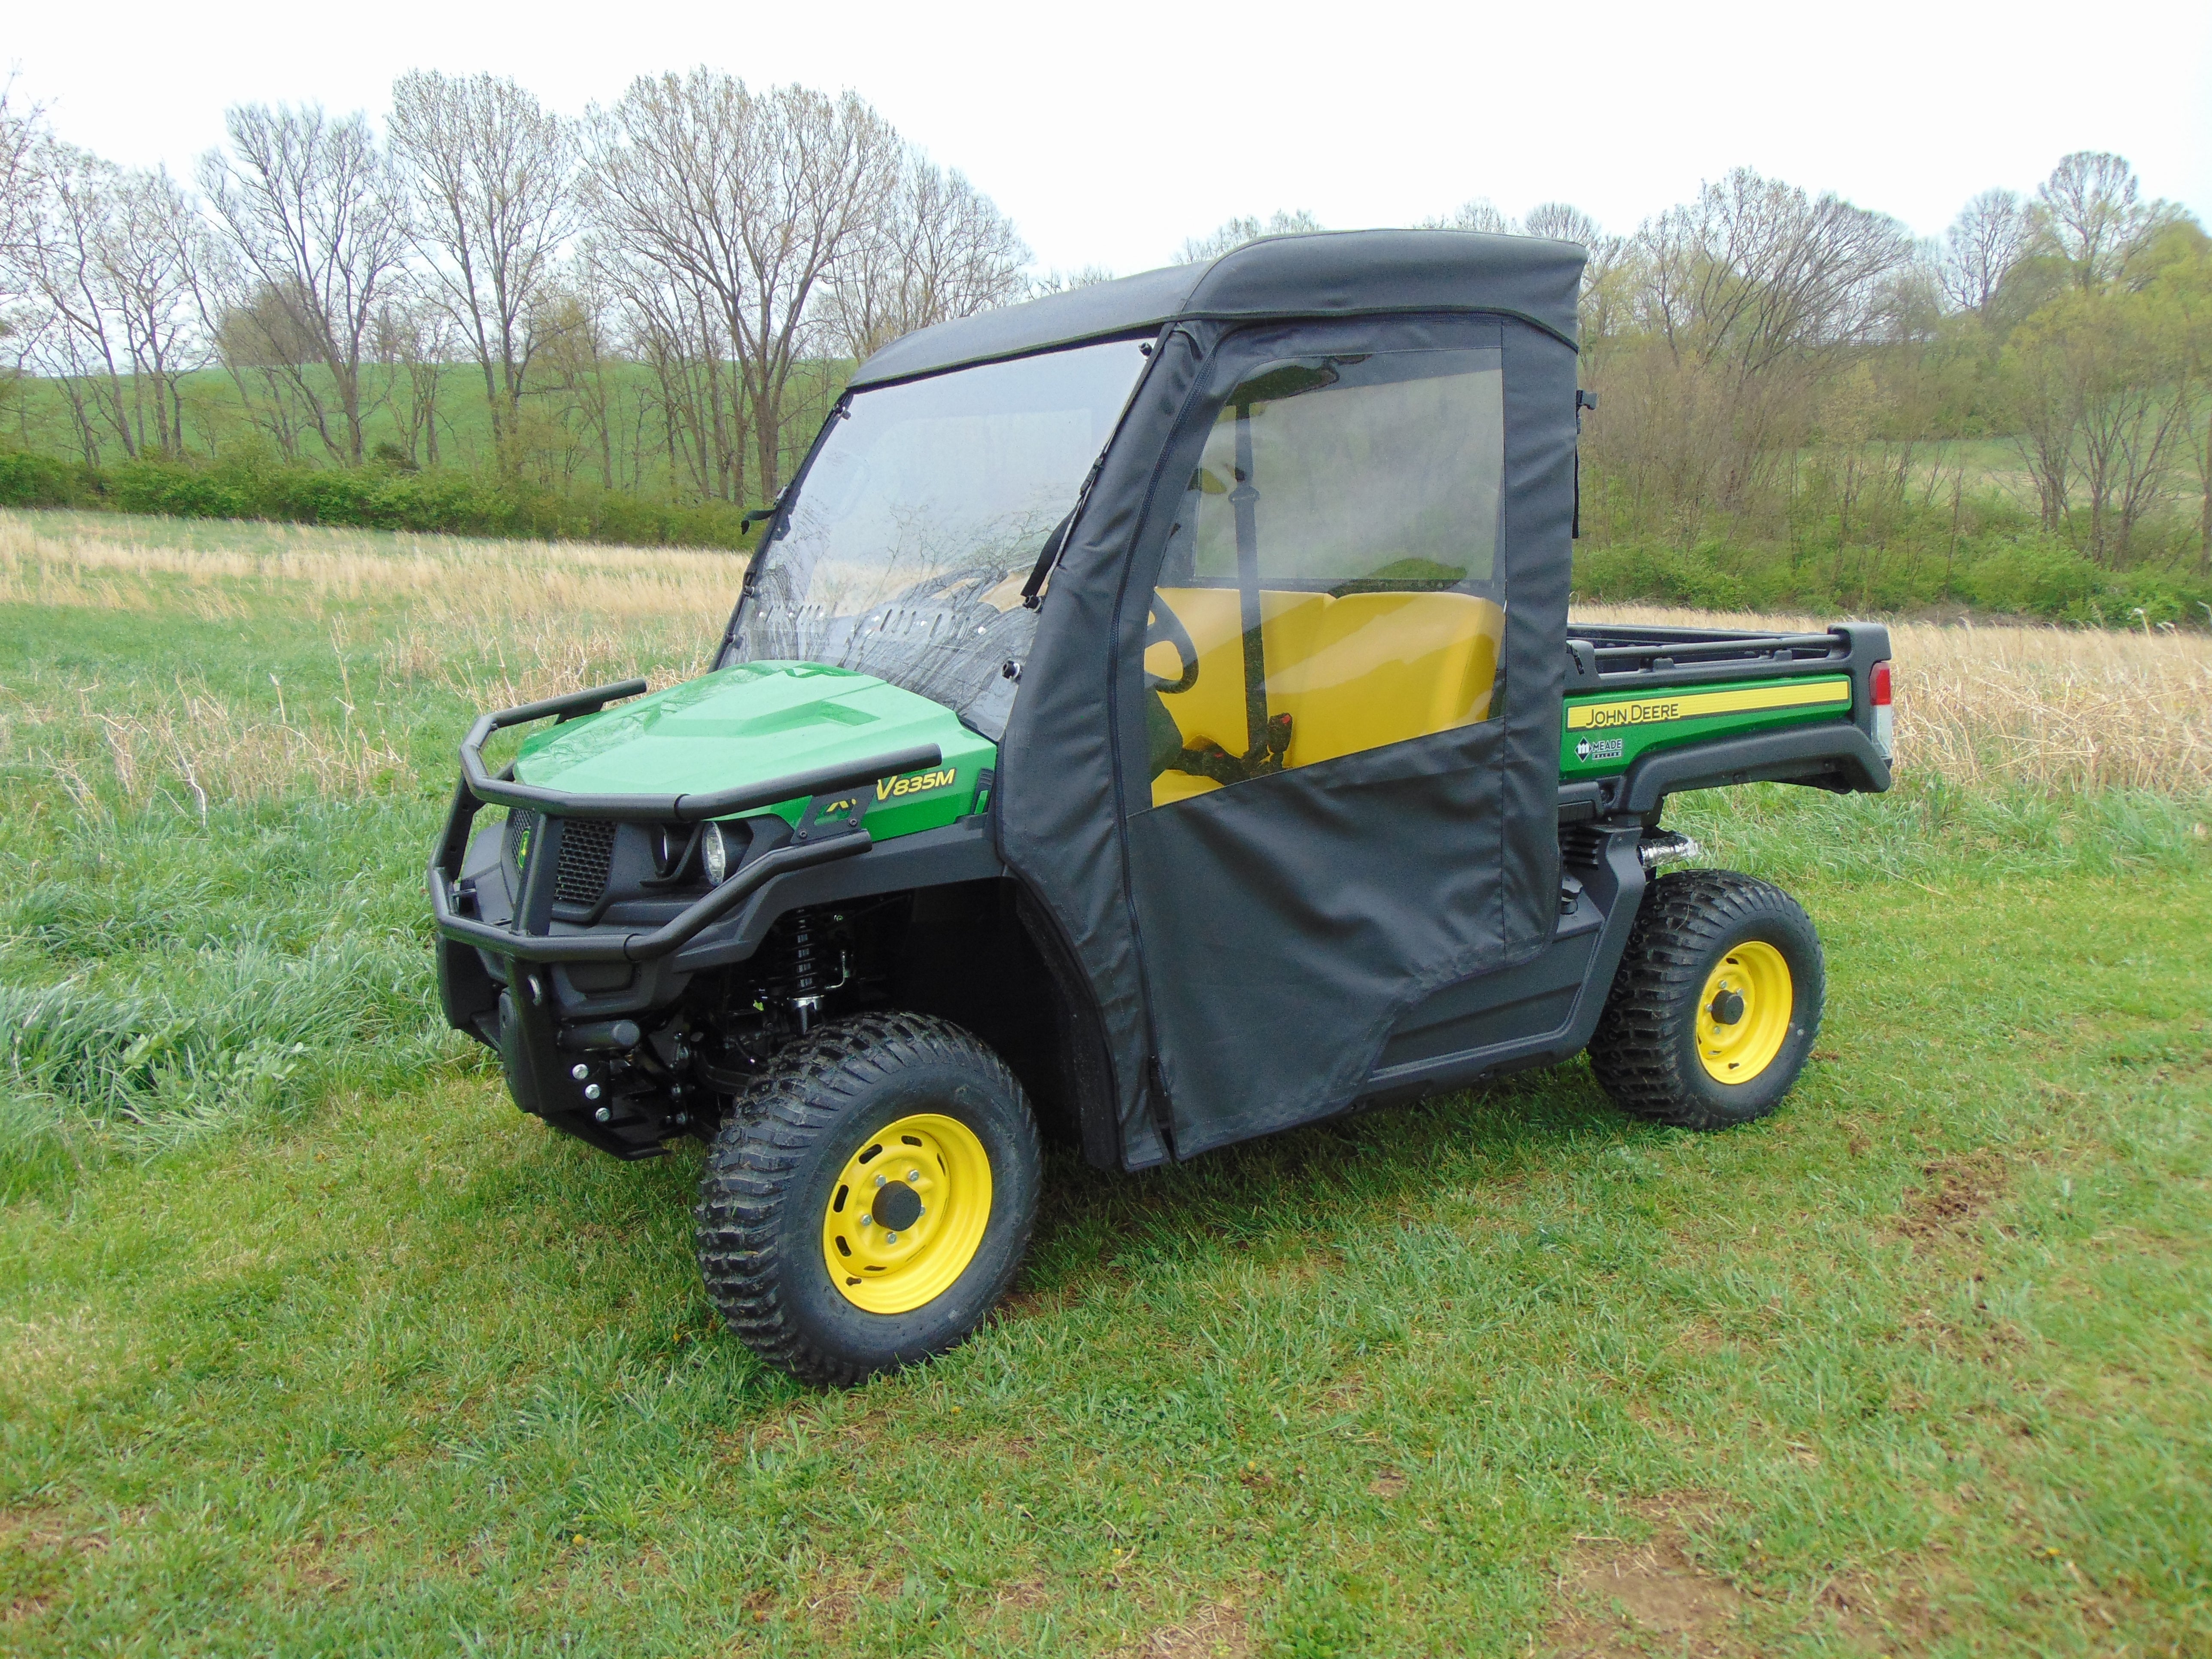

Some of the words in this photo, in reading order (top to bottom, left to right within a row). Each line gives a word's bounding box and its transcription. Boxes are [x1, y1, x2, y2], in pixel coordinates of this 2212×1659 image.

[1586, 709, 1627, 726] JOHN
[1631, 703, 1679, 721] DEERE
[1592, 738, 1622, 752] MEADE
